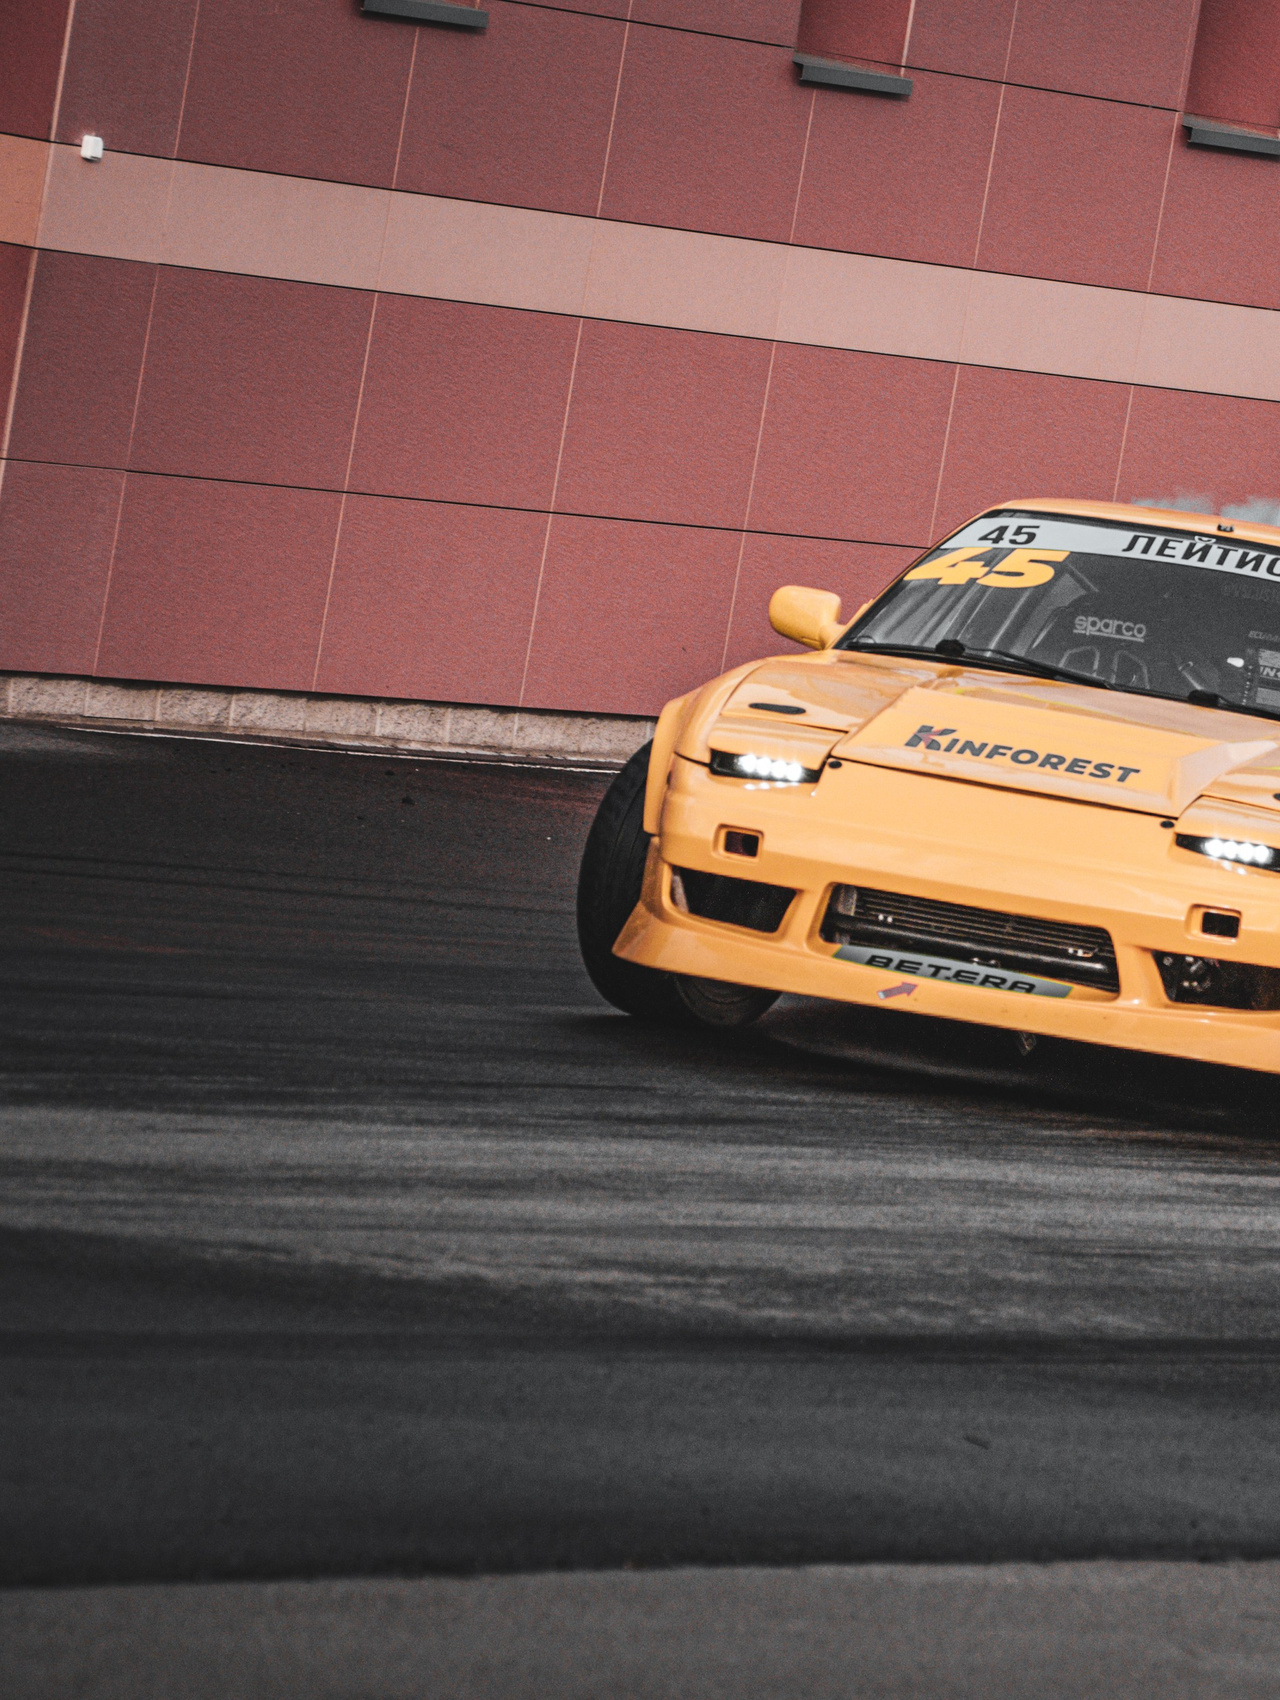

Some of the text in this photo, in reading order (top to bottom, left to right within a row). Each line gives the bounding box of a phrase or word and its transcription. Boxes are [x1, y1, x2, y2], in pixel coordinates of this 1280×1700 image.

[978, 525, 1040, 545] 45
[903, 547, 1071, 588] 45
[1074, 615, 1146, 639] sparco
[905, 725, 1141, 783] KINFOREST
